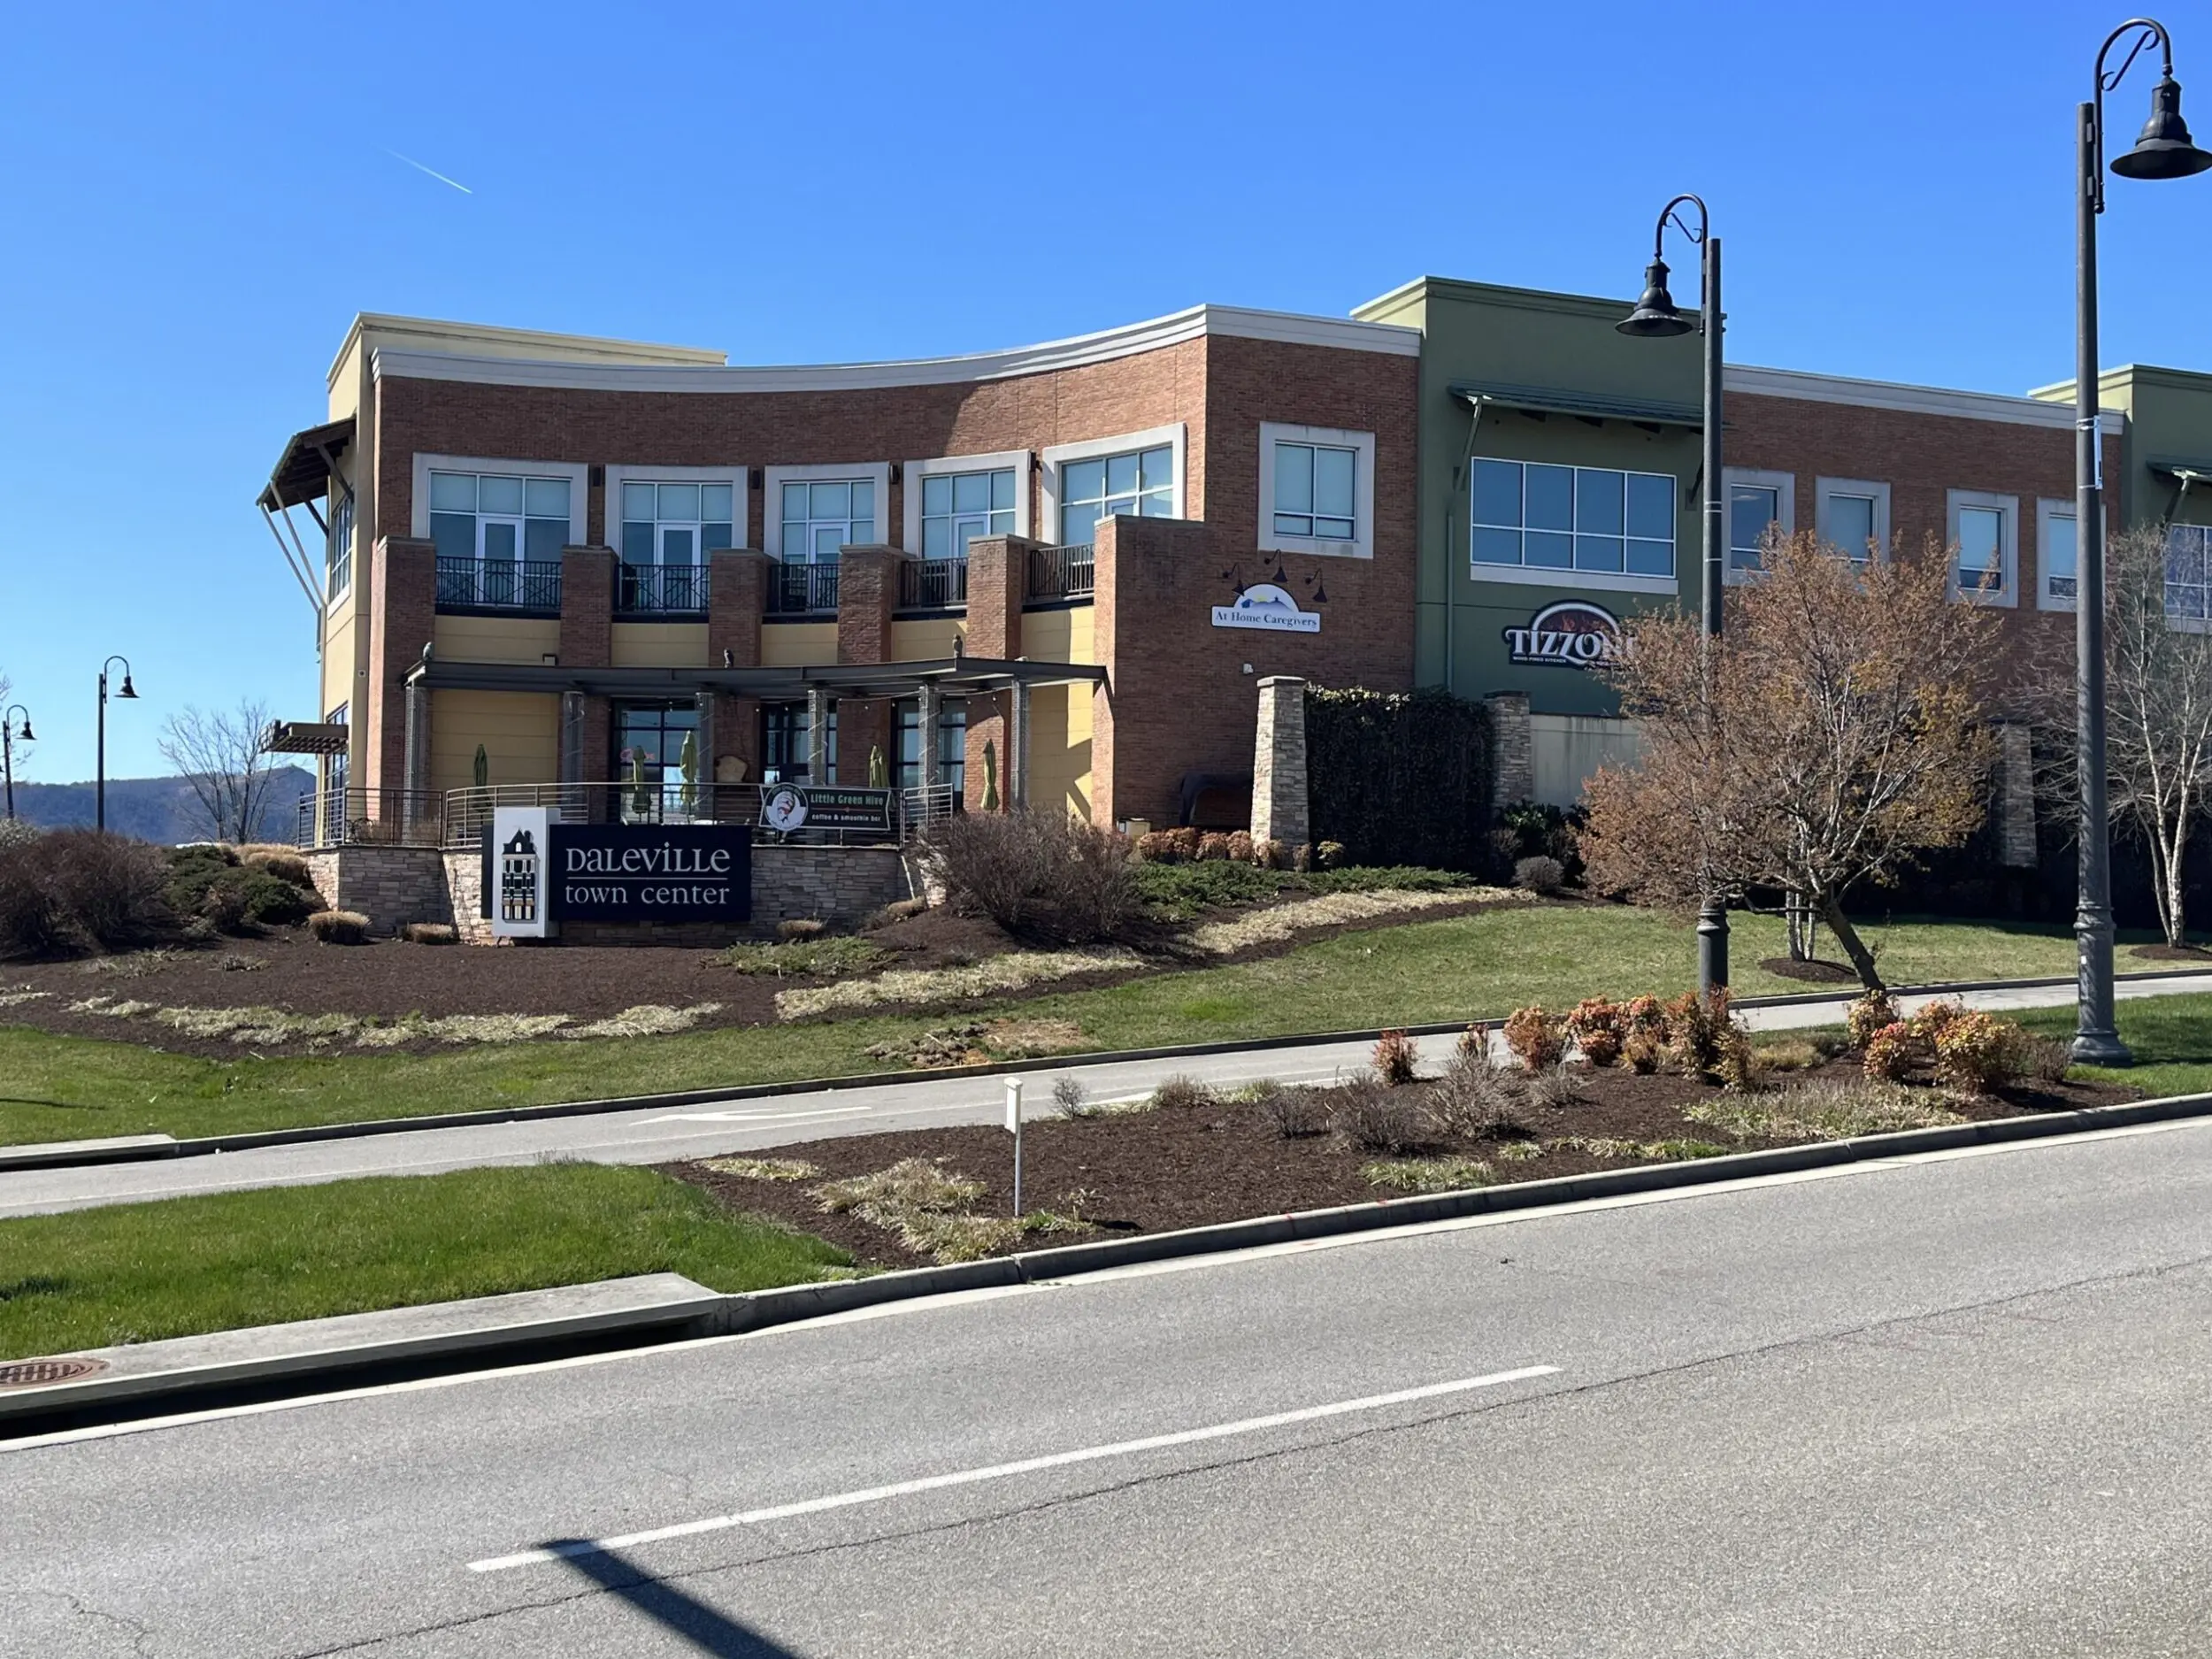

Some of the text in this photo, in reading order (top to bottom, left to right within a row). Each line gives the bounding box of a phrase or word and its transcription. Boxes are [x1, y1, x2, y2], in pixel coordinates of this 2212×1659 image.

[1217, 611, 1317, 627] At Home Caregivers
[810, 794, 834, 803] Little
[838, 795, 862, 805] Green
[565, 885, 730, 904] town center
